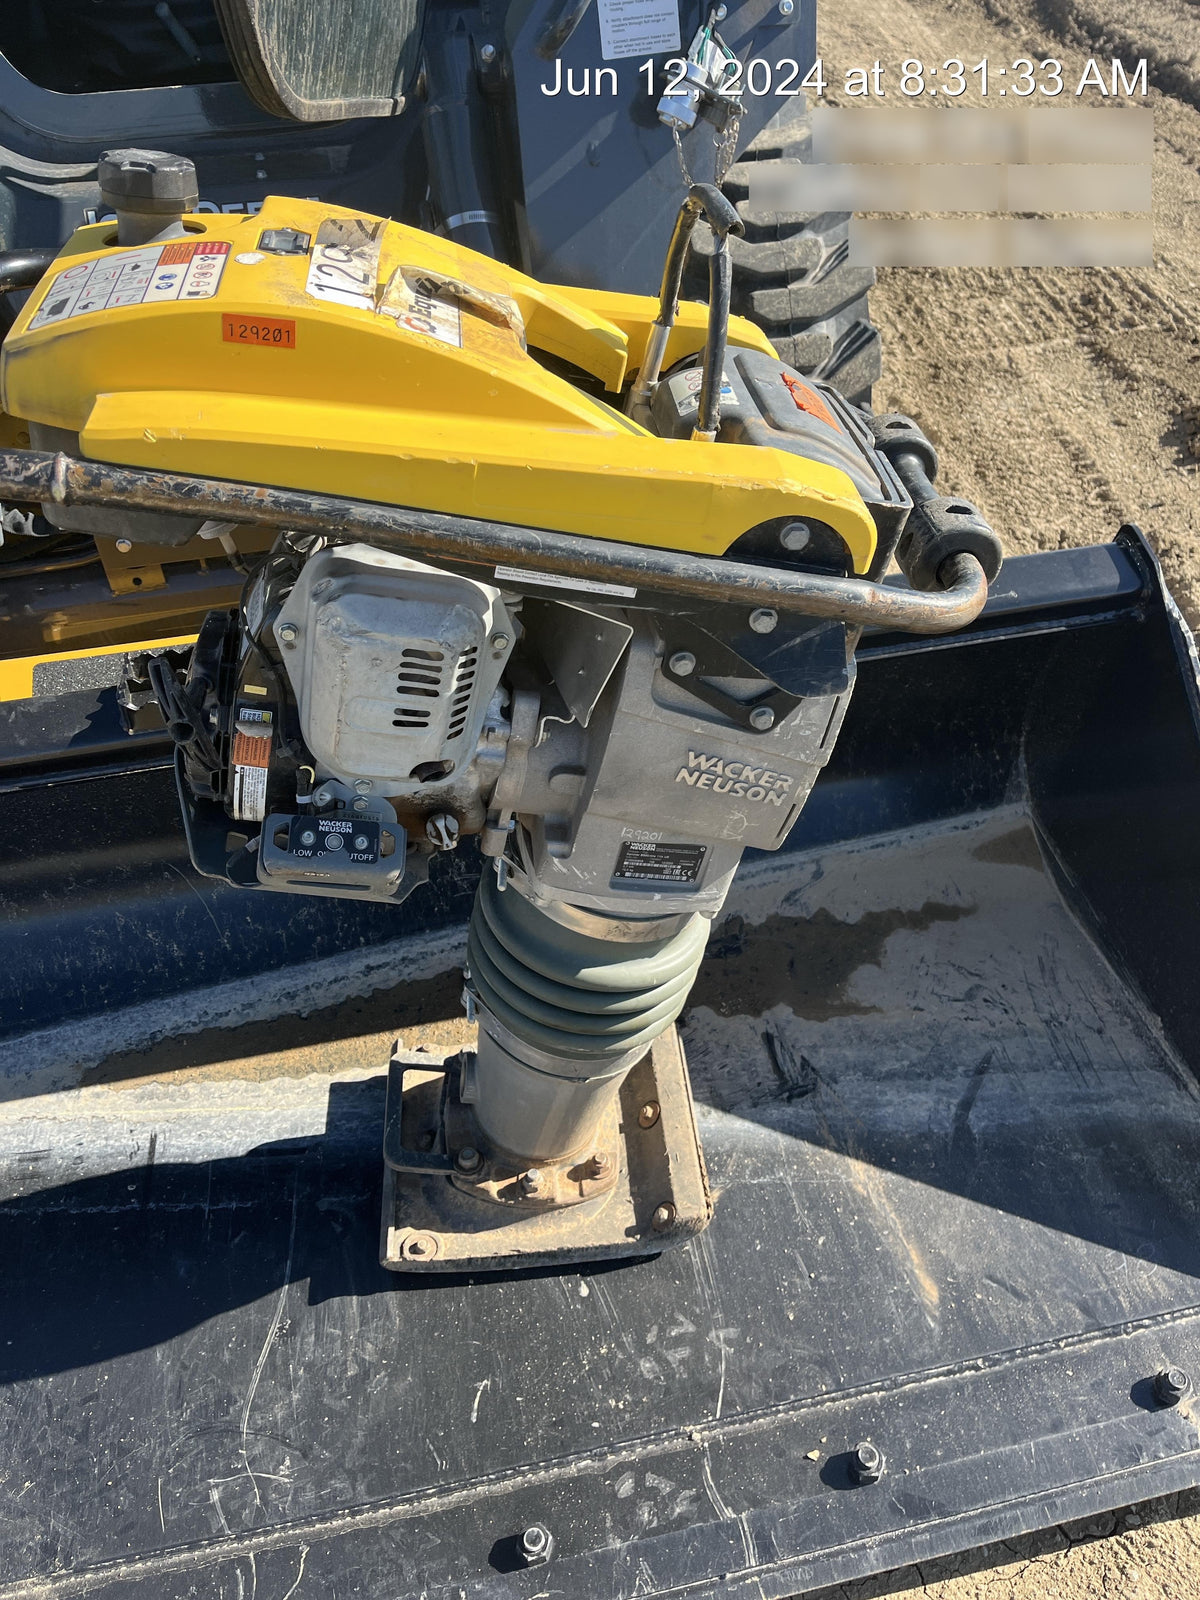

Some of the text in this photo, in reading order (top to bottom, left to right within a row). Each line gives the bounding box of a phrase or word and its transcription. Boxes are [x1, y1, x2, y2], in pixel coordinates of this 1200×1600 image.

[228, 323, 291, 343] 129201
[687, 750, 795, 793] WACKER
[675, 767, 788, 807] NEUSON
[318, 820, 352, 828] WACKER
[318, 826, 352, 834] NEUSON
[621, 827, 663, 840] 129201
